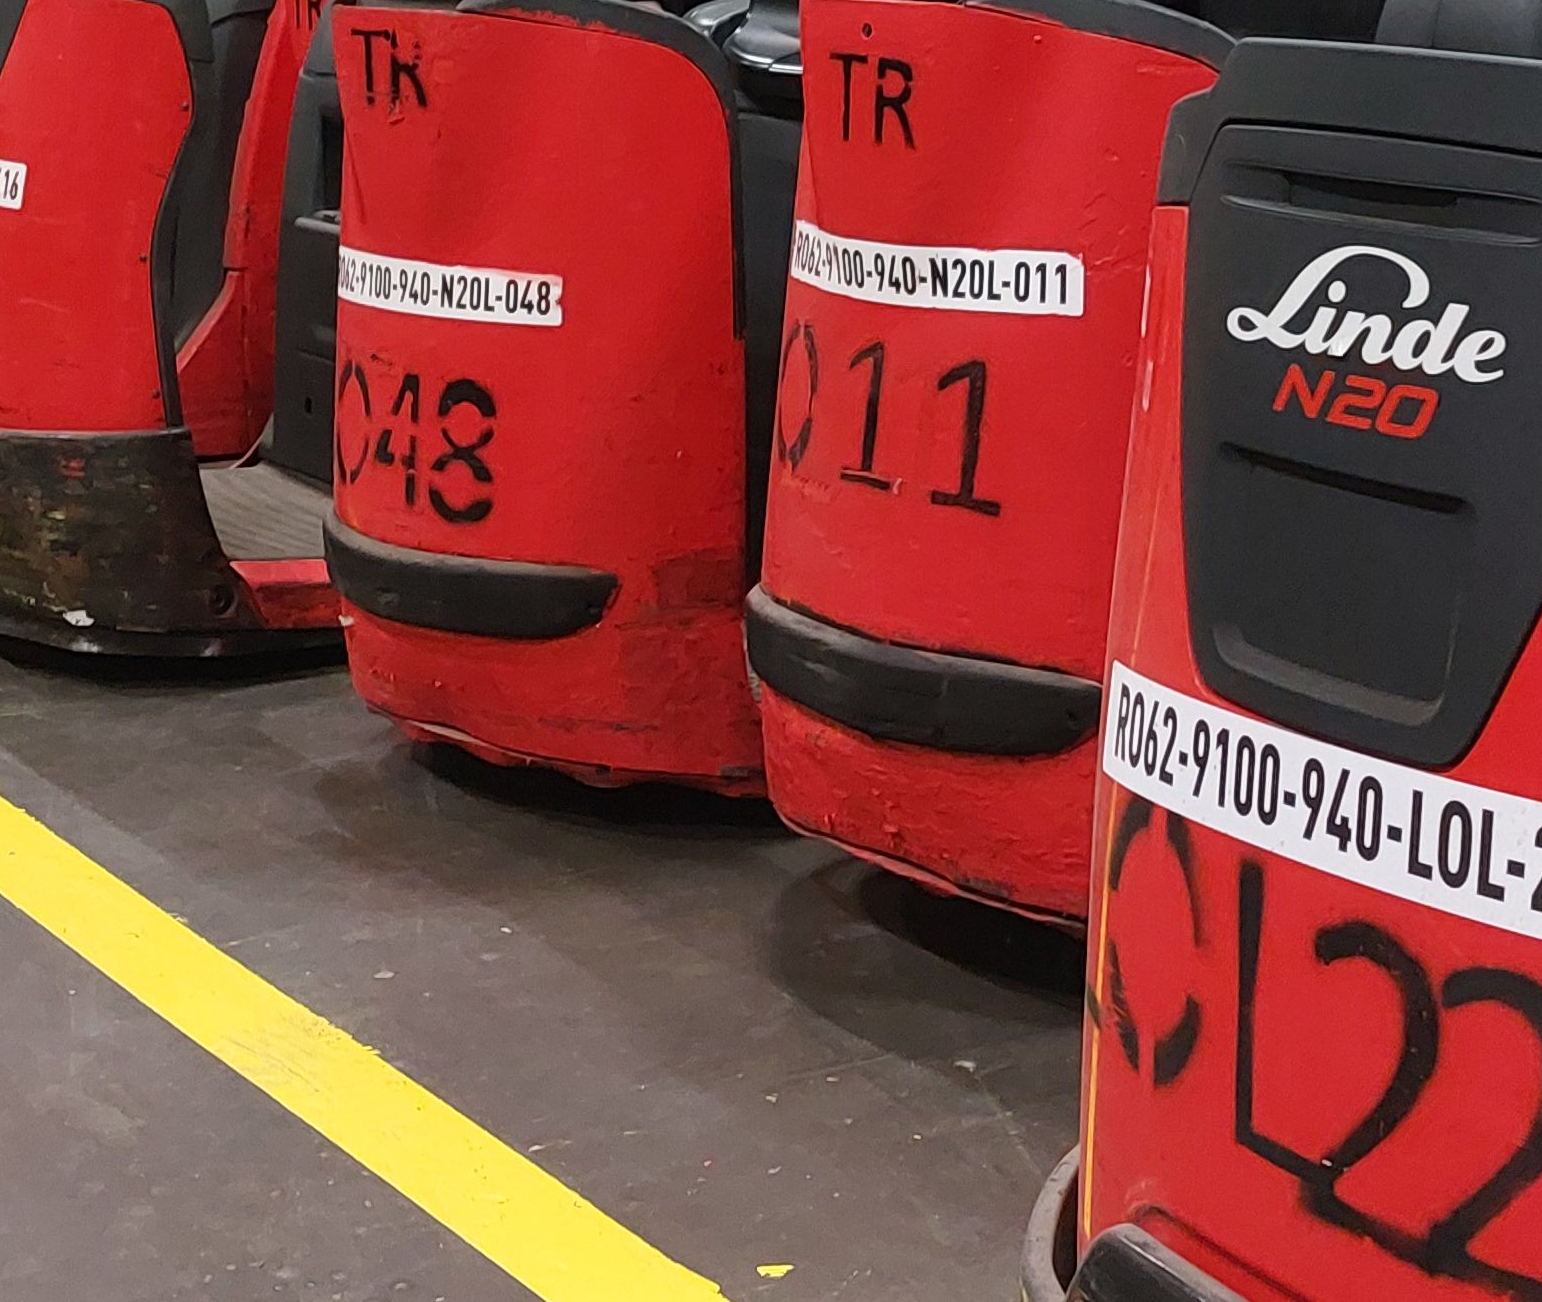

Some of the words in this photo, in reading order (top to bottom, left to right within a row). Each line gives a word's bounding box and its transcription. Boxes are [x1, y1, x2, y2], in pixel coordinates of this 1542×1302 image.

[828, 52, 916, 150] TR
[794, 230, 1069, 305] R062-9100-940-N20L-011
[1226, 245, 1507, 384] Linde
[337, 359, 497, 524] 048
[777, 318, 1001, 517] 011
[1272, 364, 1440, 439] N20
